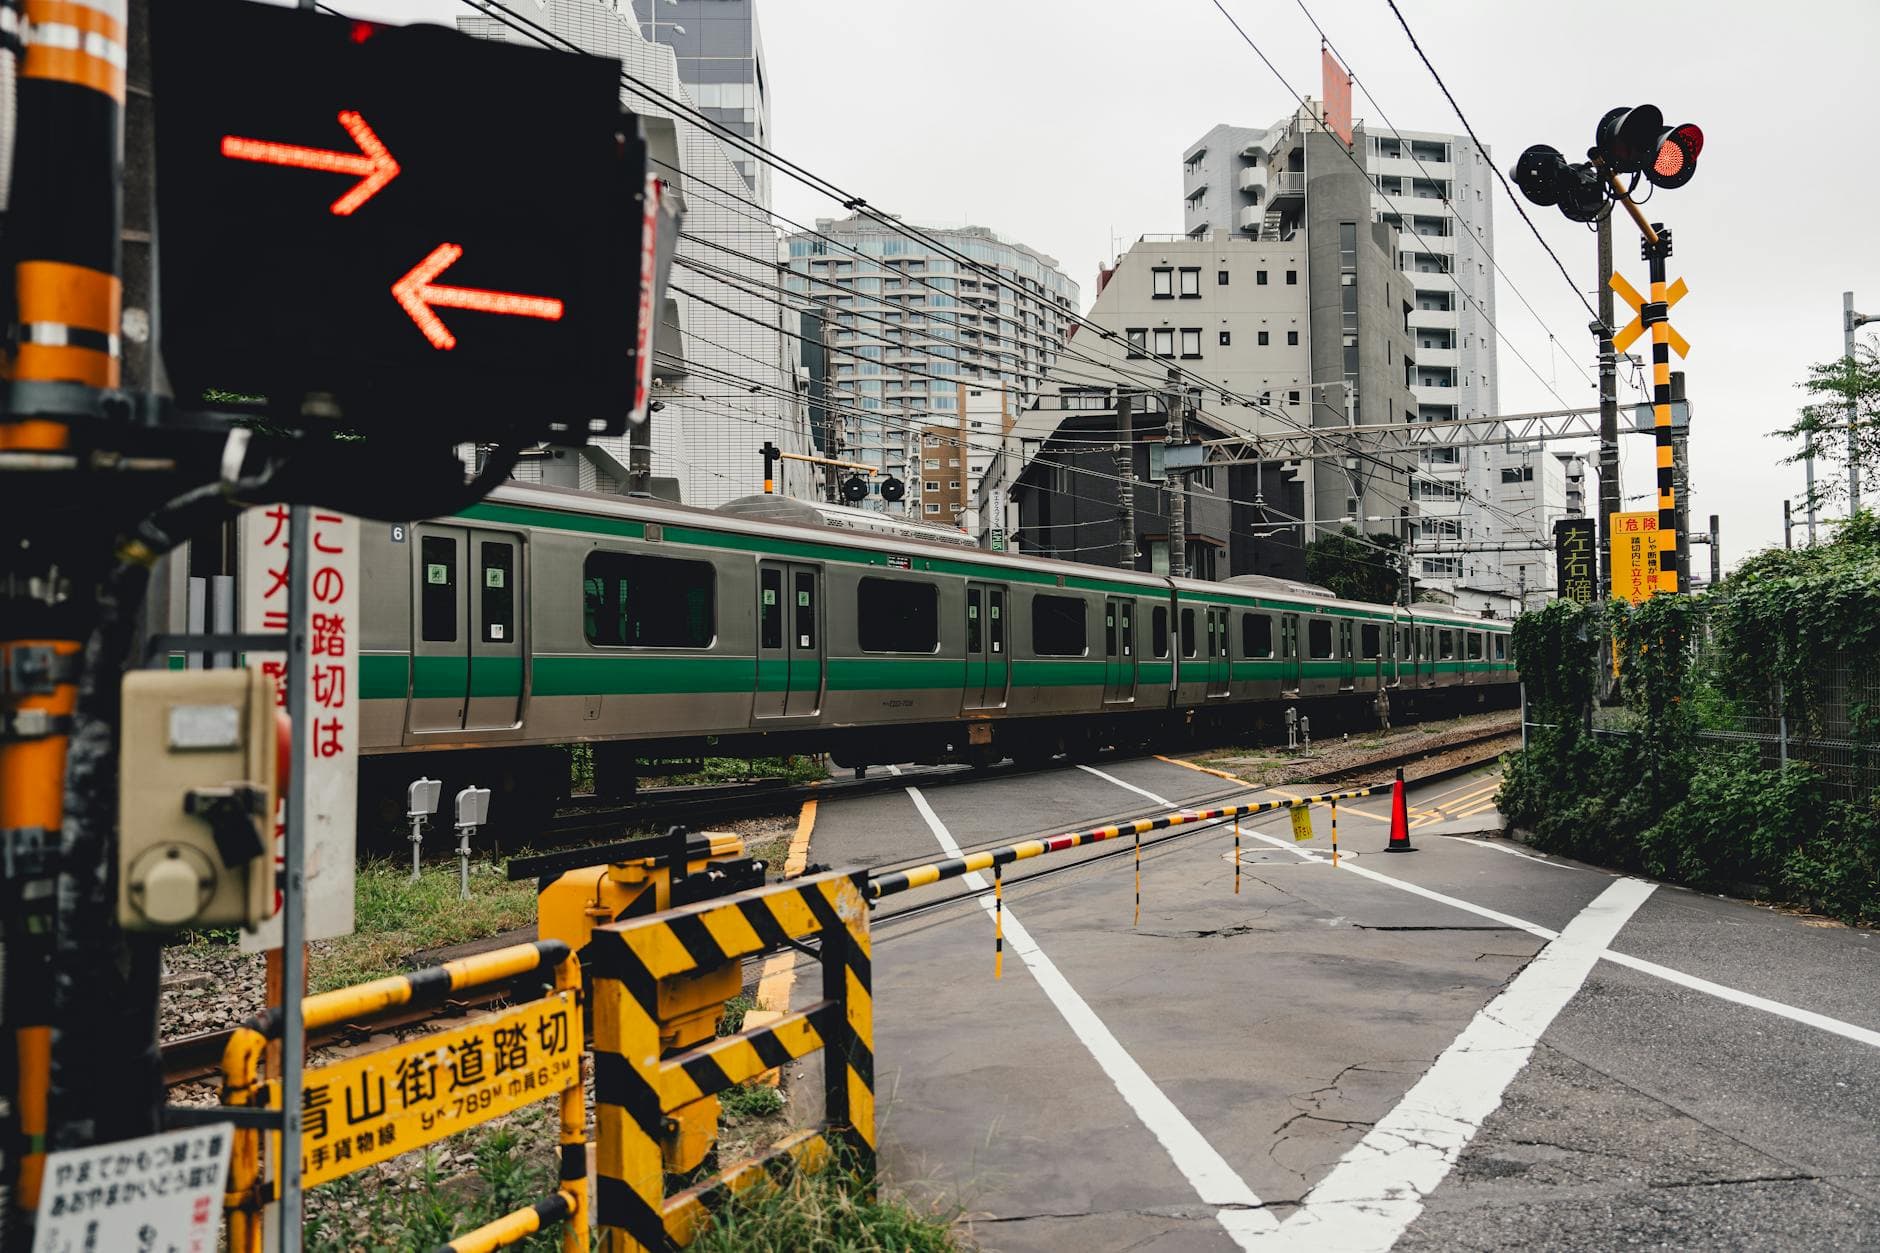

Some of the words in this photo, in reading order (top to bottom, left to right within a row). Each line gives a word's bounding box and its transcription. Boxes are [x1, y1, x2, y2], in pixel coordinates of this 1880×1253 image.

[393, 527, 403, 540] 6
[311, 514, 345, 758] この踏切は
[302, 1010, 568, 1140] 青山街道踏切
